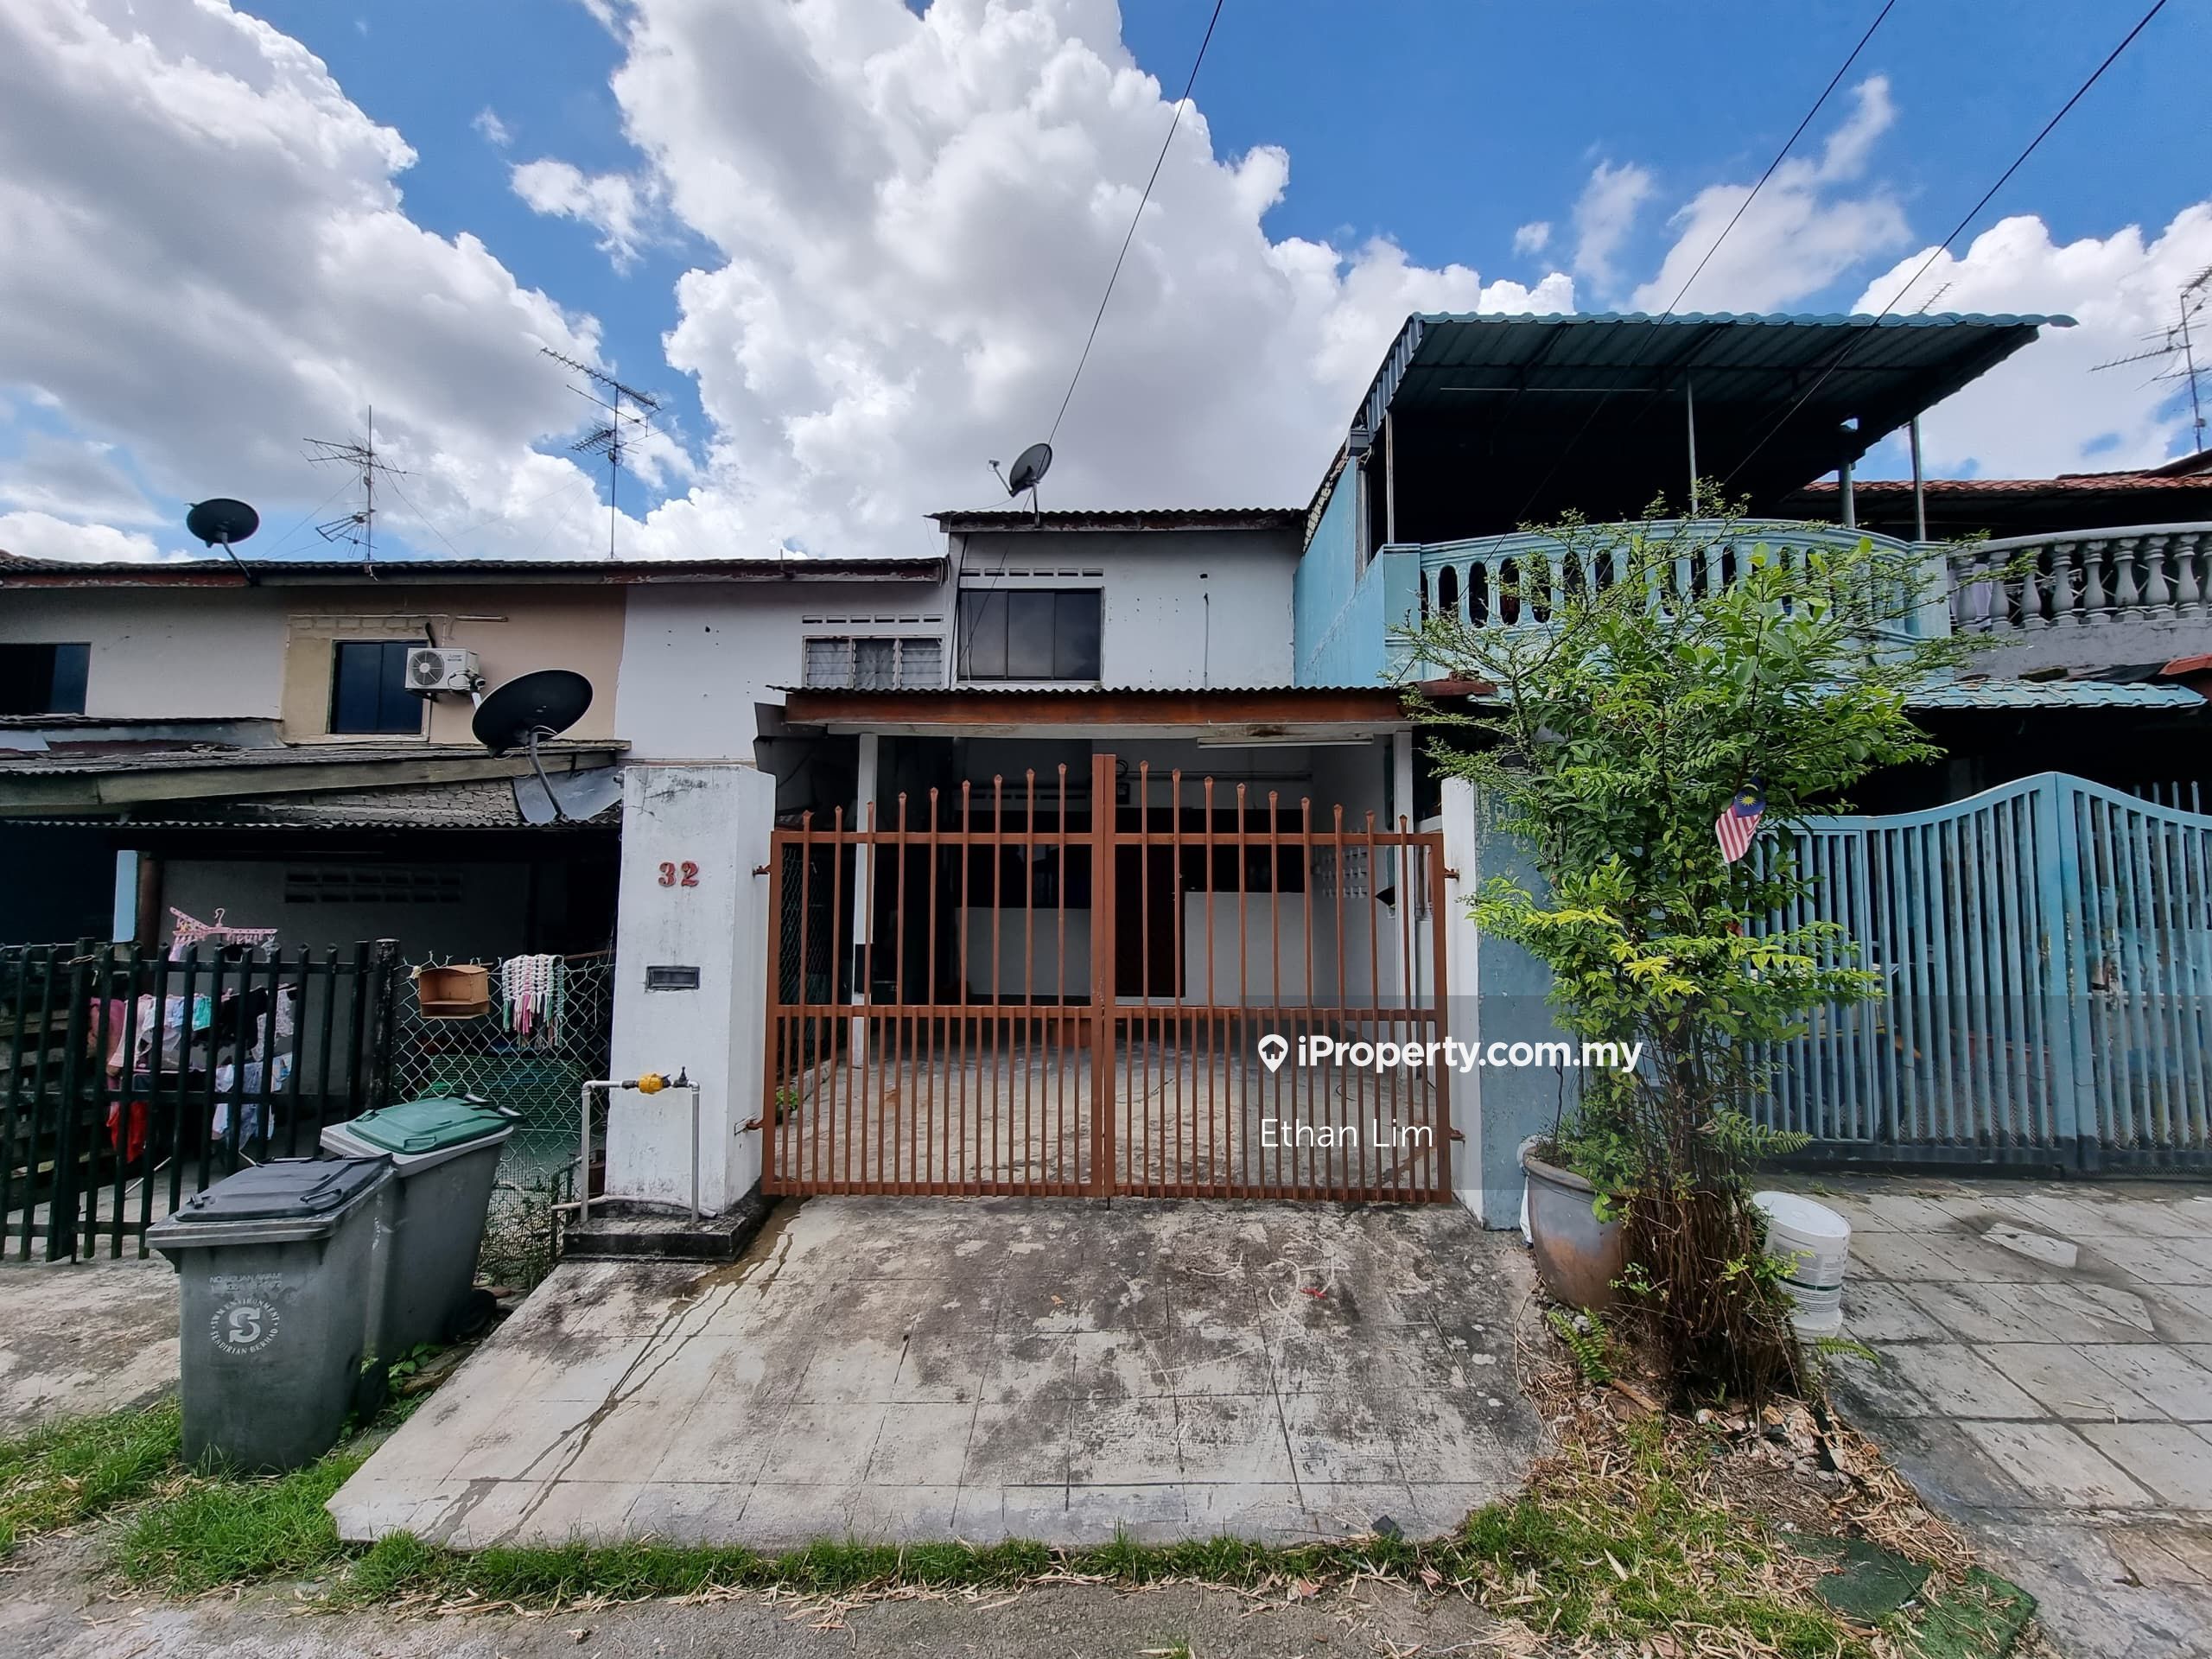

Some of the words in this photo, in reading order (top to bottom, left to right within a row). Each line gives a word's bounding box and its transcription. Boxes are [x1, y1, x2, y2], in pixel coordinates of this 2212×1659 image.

[658, 861, 699, 887] 32
[224, 1298, 280, 1321] ENVIRONMENT
[210, 1331, 248, 1355] SENDIRIAN
[250, 1328, 278, 1353] BERHAD
